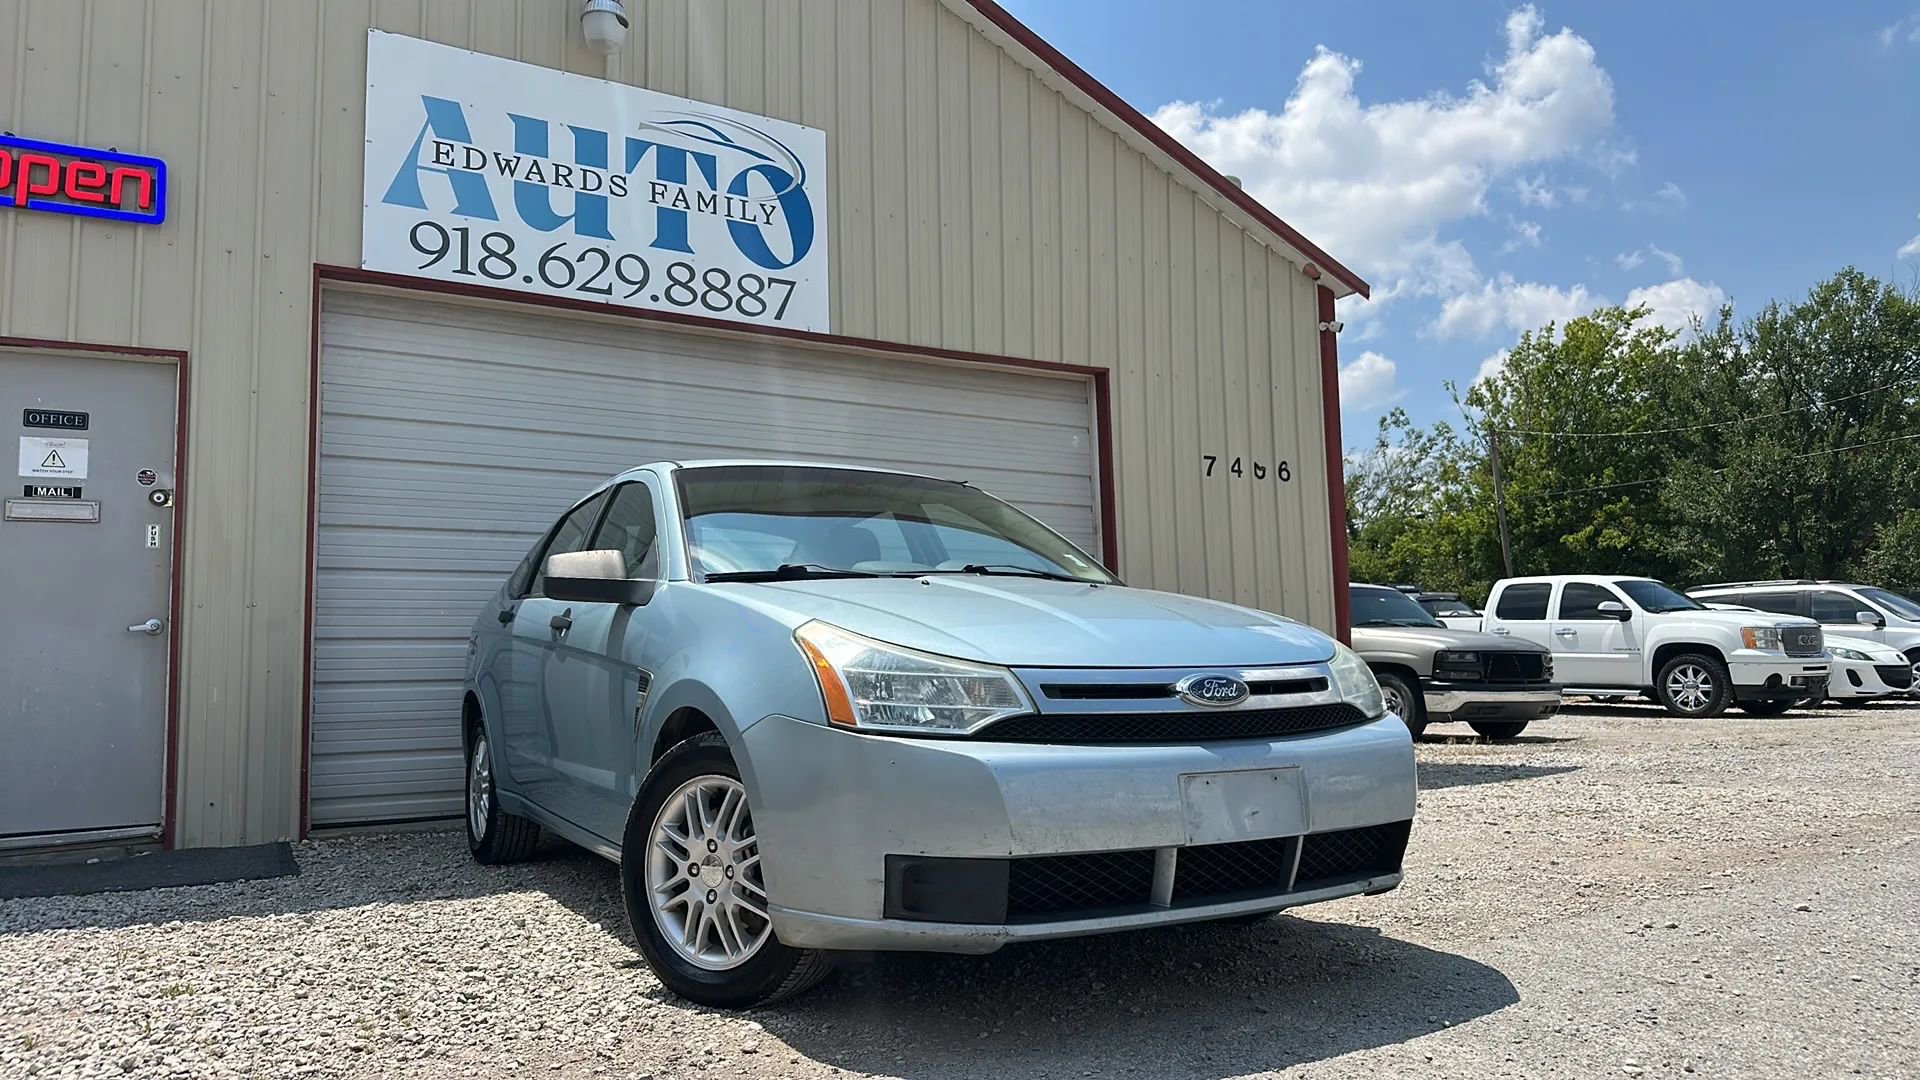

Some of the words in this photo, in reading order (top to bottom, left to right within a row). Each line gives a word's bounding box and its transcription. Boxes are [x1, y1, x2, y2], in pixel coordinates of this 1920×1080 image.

[0, 149, 152, 209] pen
[431, 140, 629, 198] EDWARDS
[648, 181, 777, 226] FAMILY
[408, 220, 797, 321] 918.629.8887
[29, 413, 83, 426] OFFICE
[37, 487, 69, 496] MAIL
[1202, 678, 1239, 698] Ford
